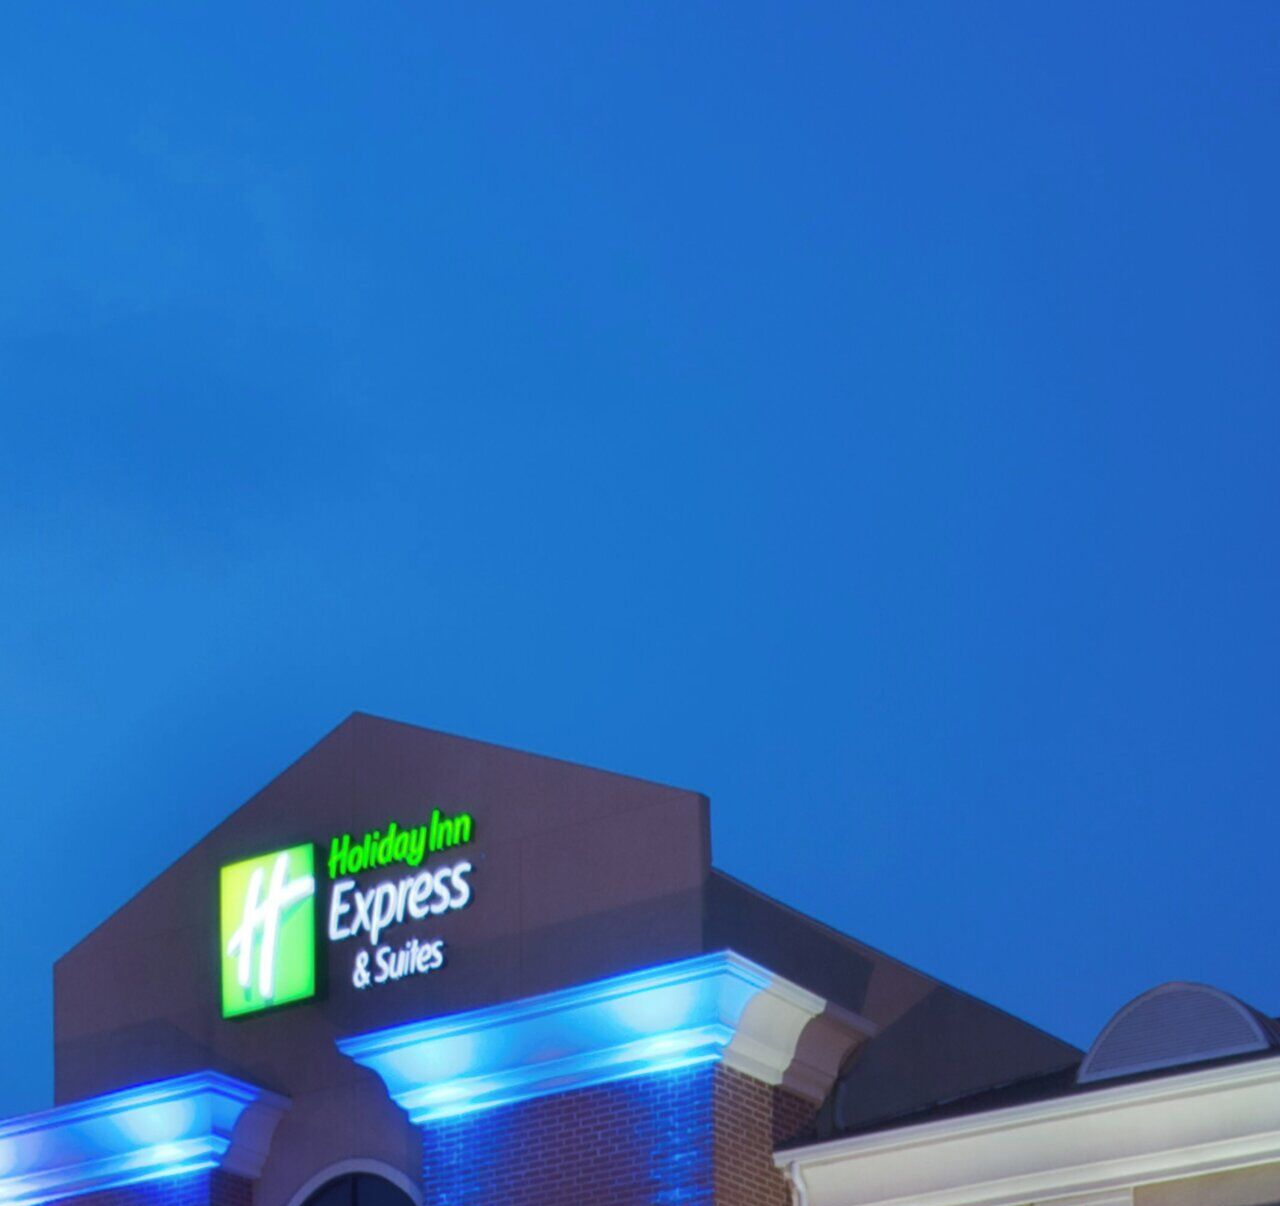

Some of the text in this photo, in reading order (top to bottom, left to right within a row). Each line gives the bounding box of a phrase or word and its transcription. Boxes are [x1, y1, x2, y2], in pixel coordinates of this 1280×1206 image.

[328, 808, 472, 879] Holiday Inn
[328, 861, 472, 945] Express
[352, 939, 444, 989] & Suites
